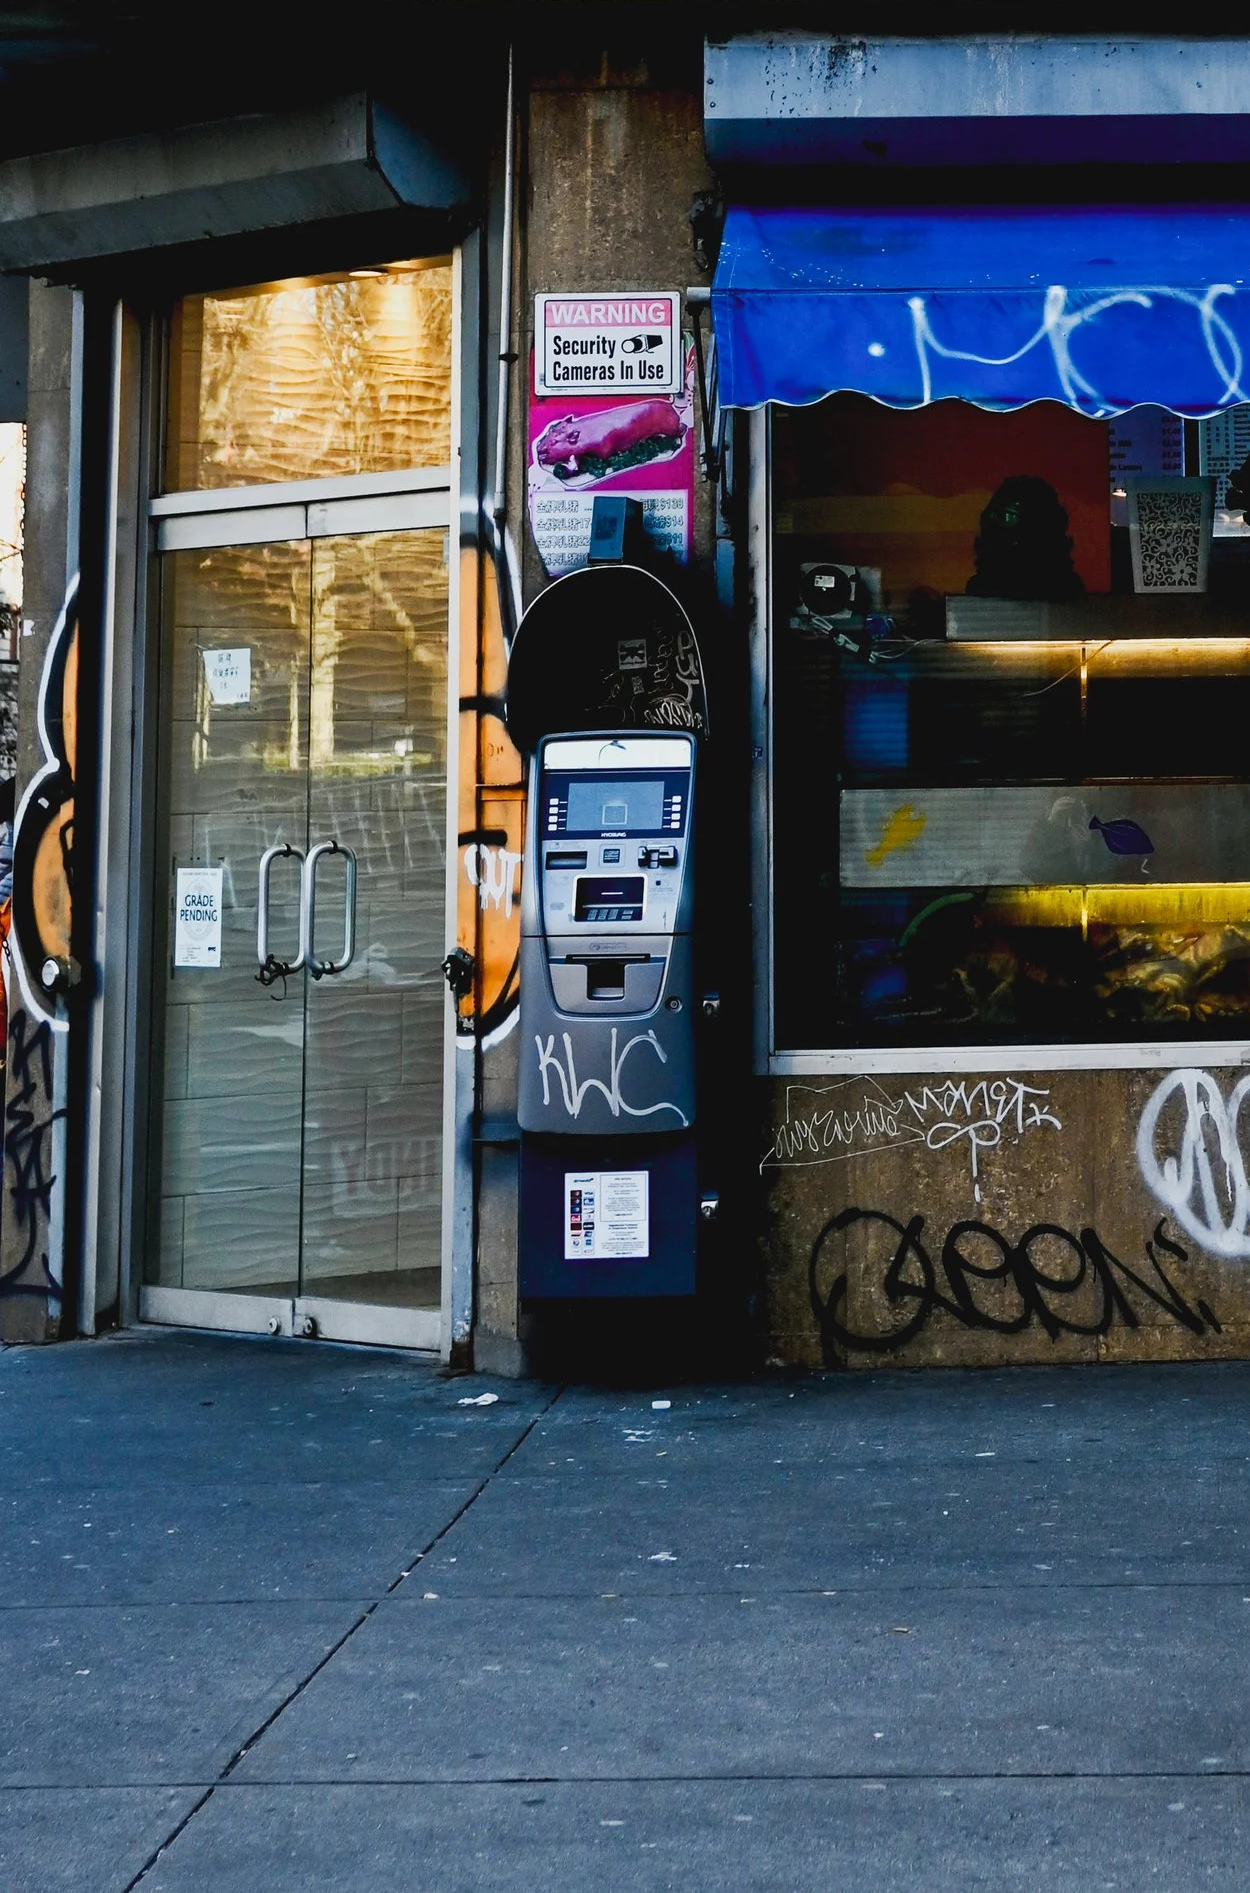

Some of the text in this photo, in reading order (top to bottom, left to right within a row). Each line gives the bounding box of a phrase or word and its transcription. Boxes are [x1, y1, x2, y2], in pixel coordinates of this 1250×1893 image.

[551, 302, 666, 324] WARNING
[552, 335, 616, 358] Security
[552, 359, 664, 382] Cameras In Use
[184, 894, 214, 907] GRADE
[180, 908, 218, 922] PENDING
